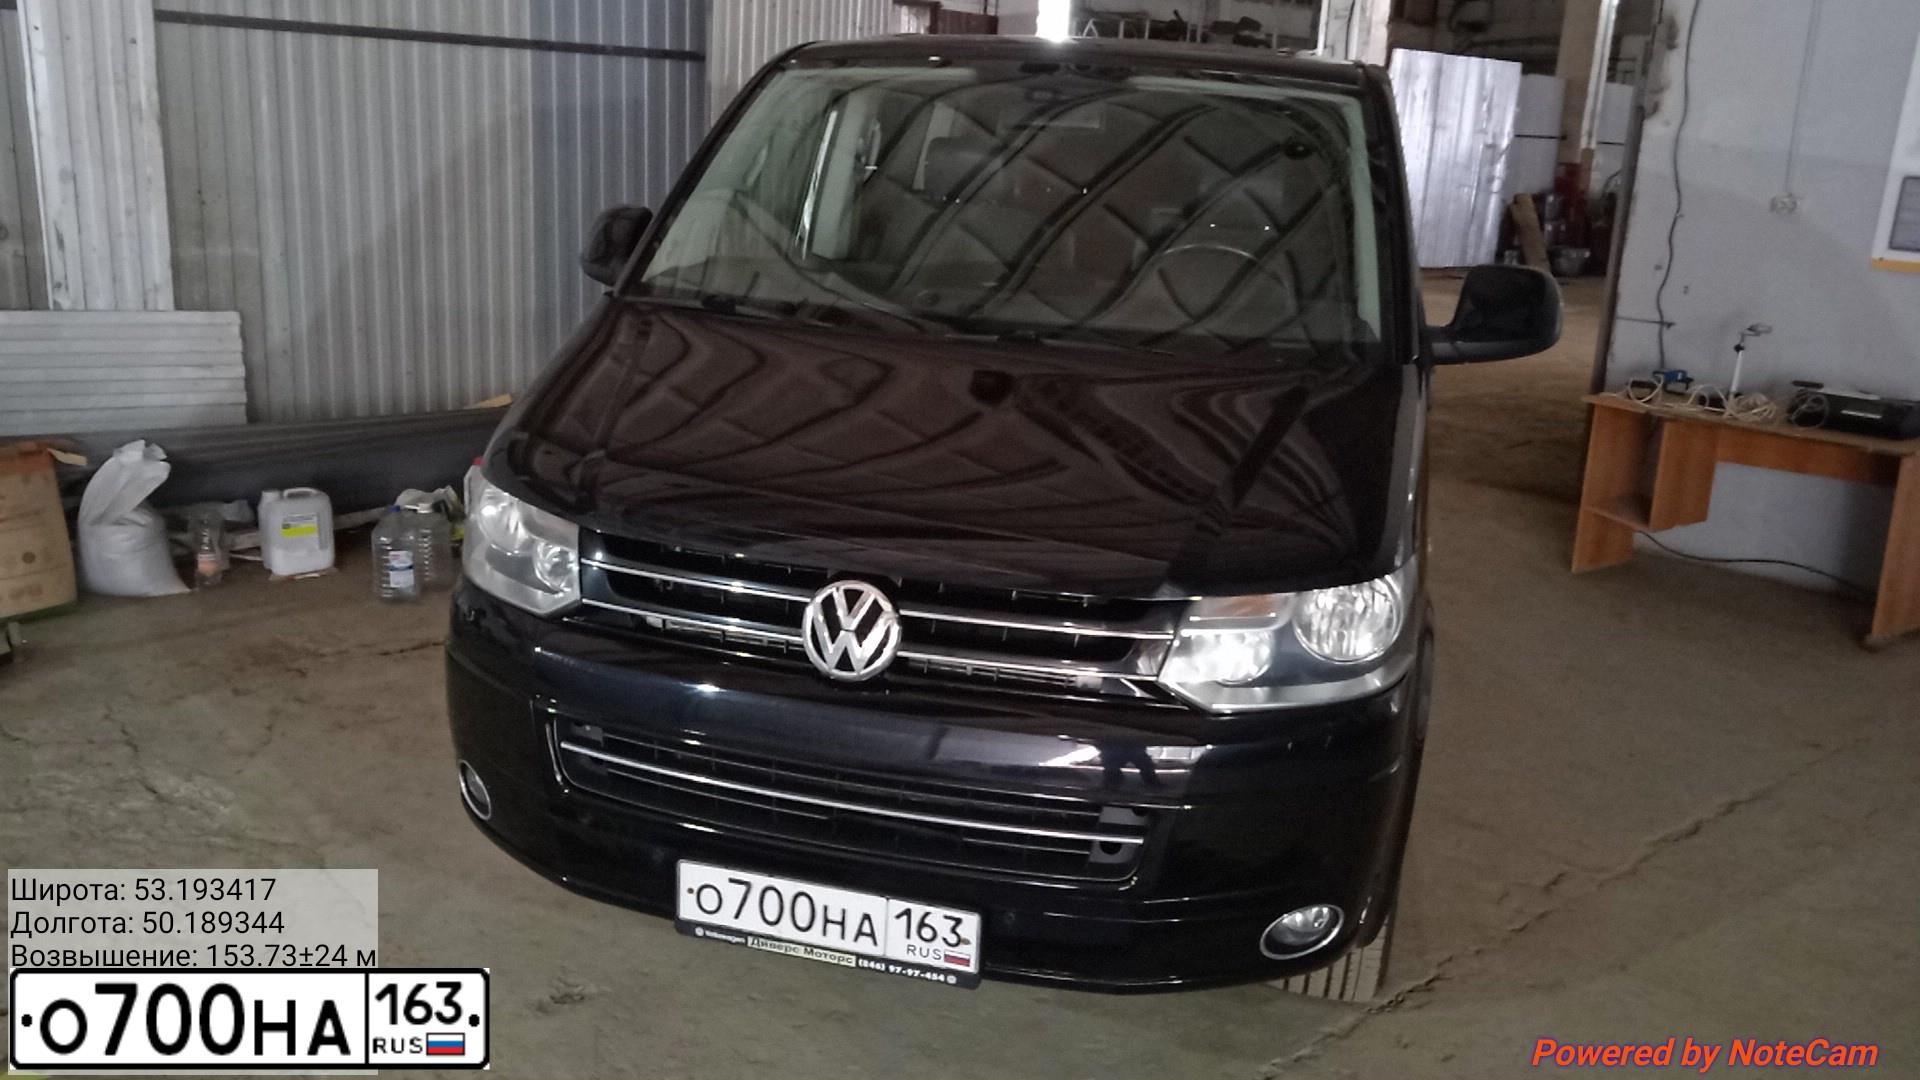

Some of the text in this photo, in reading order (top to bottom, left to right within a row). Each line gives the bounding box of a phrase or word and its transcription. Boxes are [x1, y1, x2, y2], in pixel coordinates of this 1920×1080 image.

[802, 580, 901, 680] VW
[894, 907, 963, 949] 163
[750, 937, 800, 954] Диверс
[803, 947, 854, 964] Моторс
[906, 943, 942, 961] RUS
